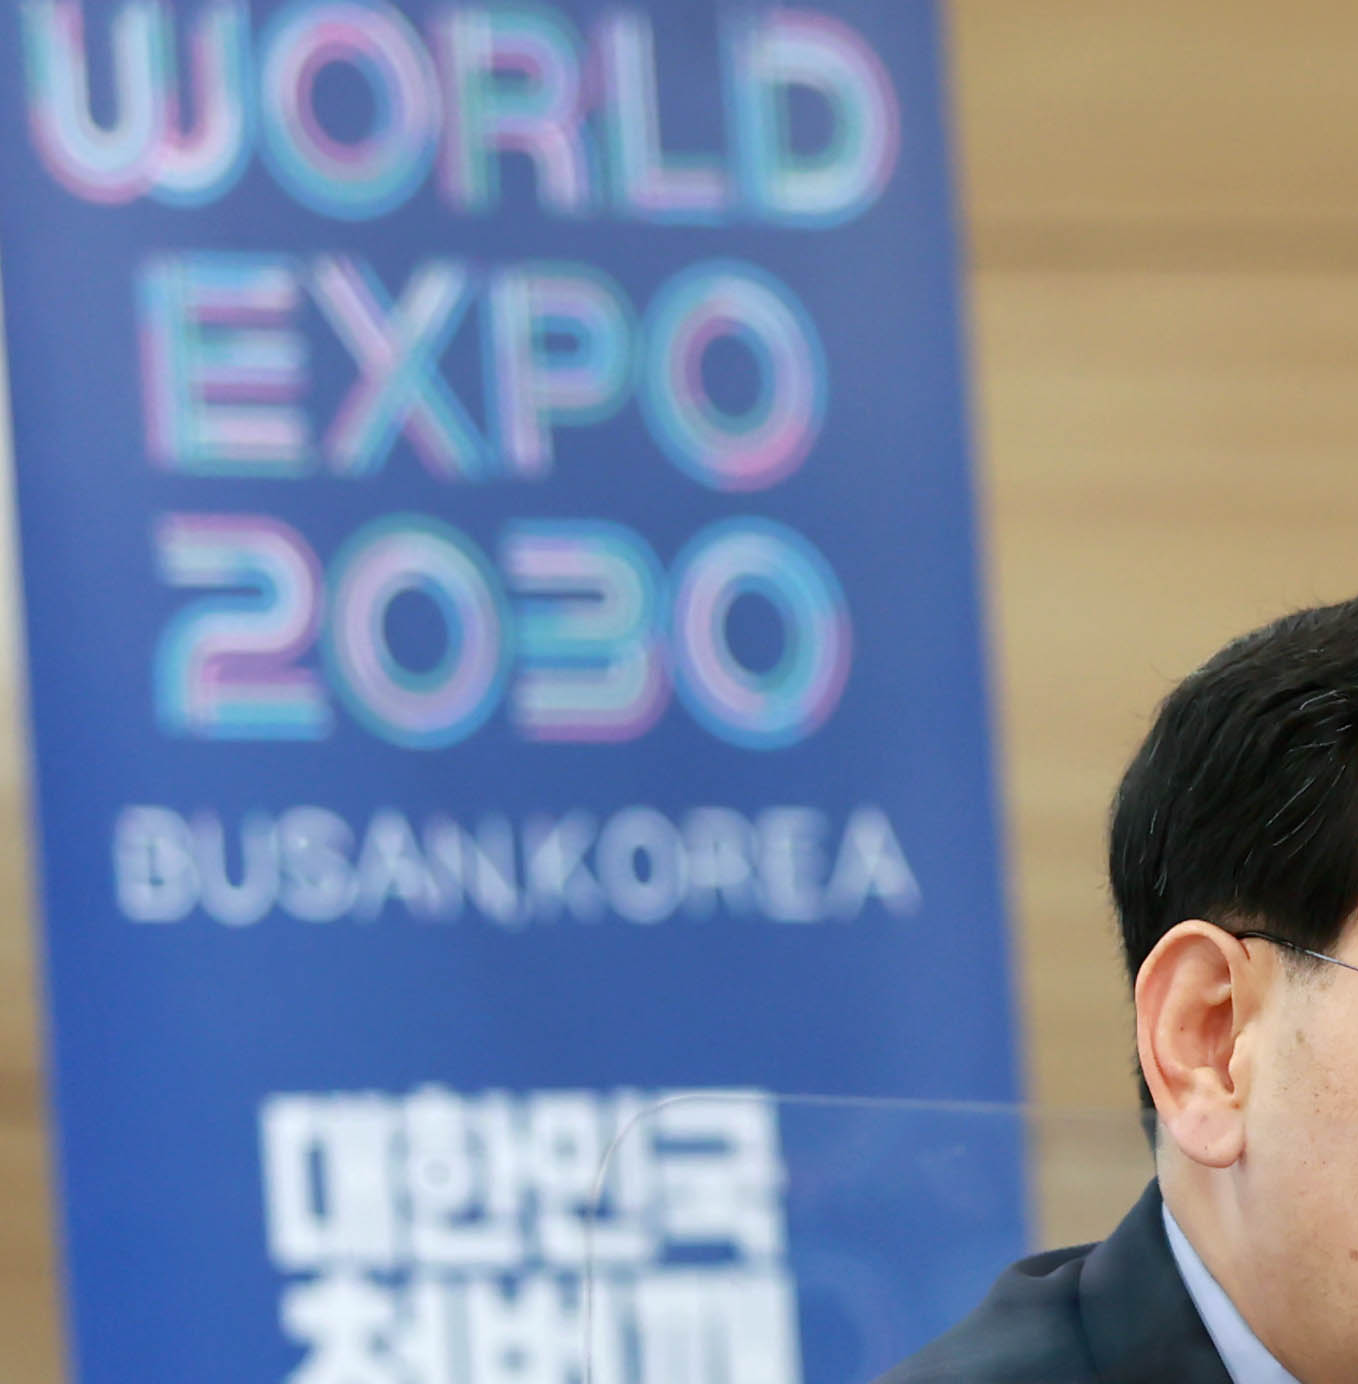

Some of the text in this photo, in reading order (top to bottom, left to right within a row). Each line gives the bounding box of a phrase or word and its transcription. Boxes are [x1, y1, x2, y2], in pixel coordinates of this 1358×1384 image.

[22, 0, 902, 230] WORLD
[137, 250, 828, 492] EXPO
[152, 511, 853, 750] 2030
[260, 1085, 787, 1271] 대한민국
